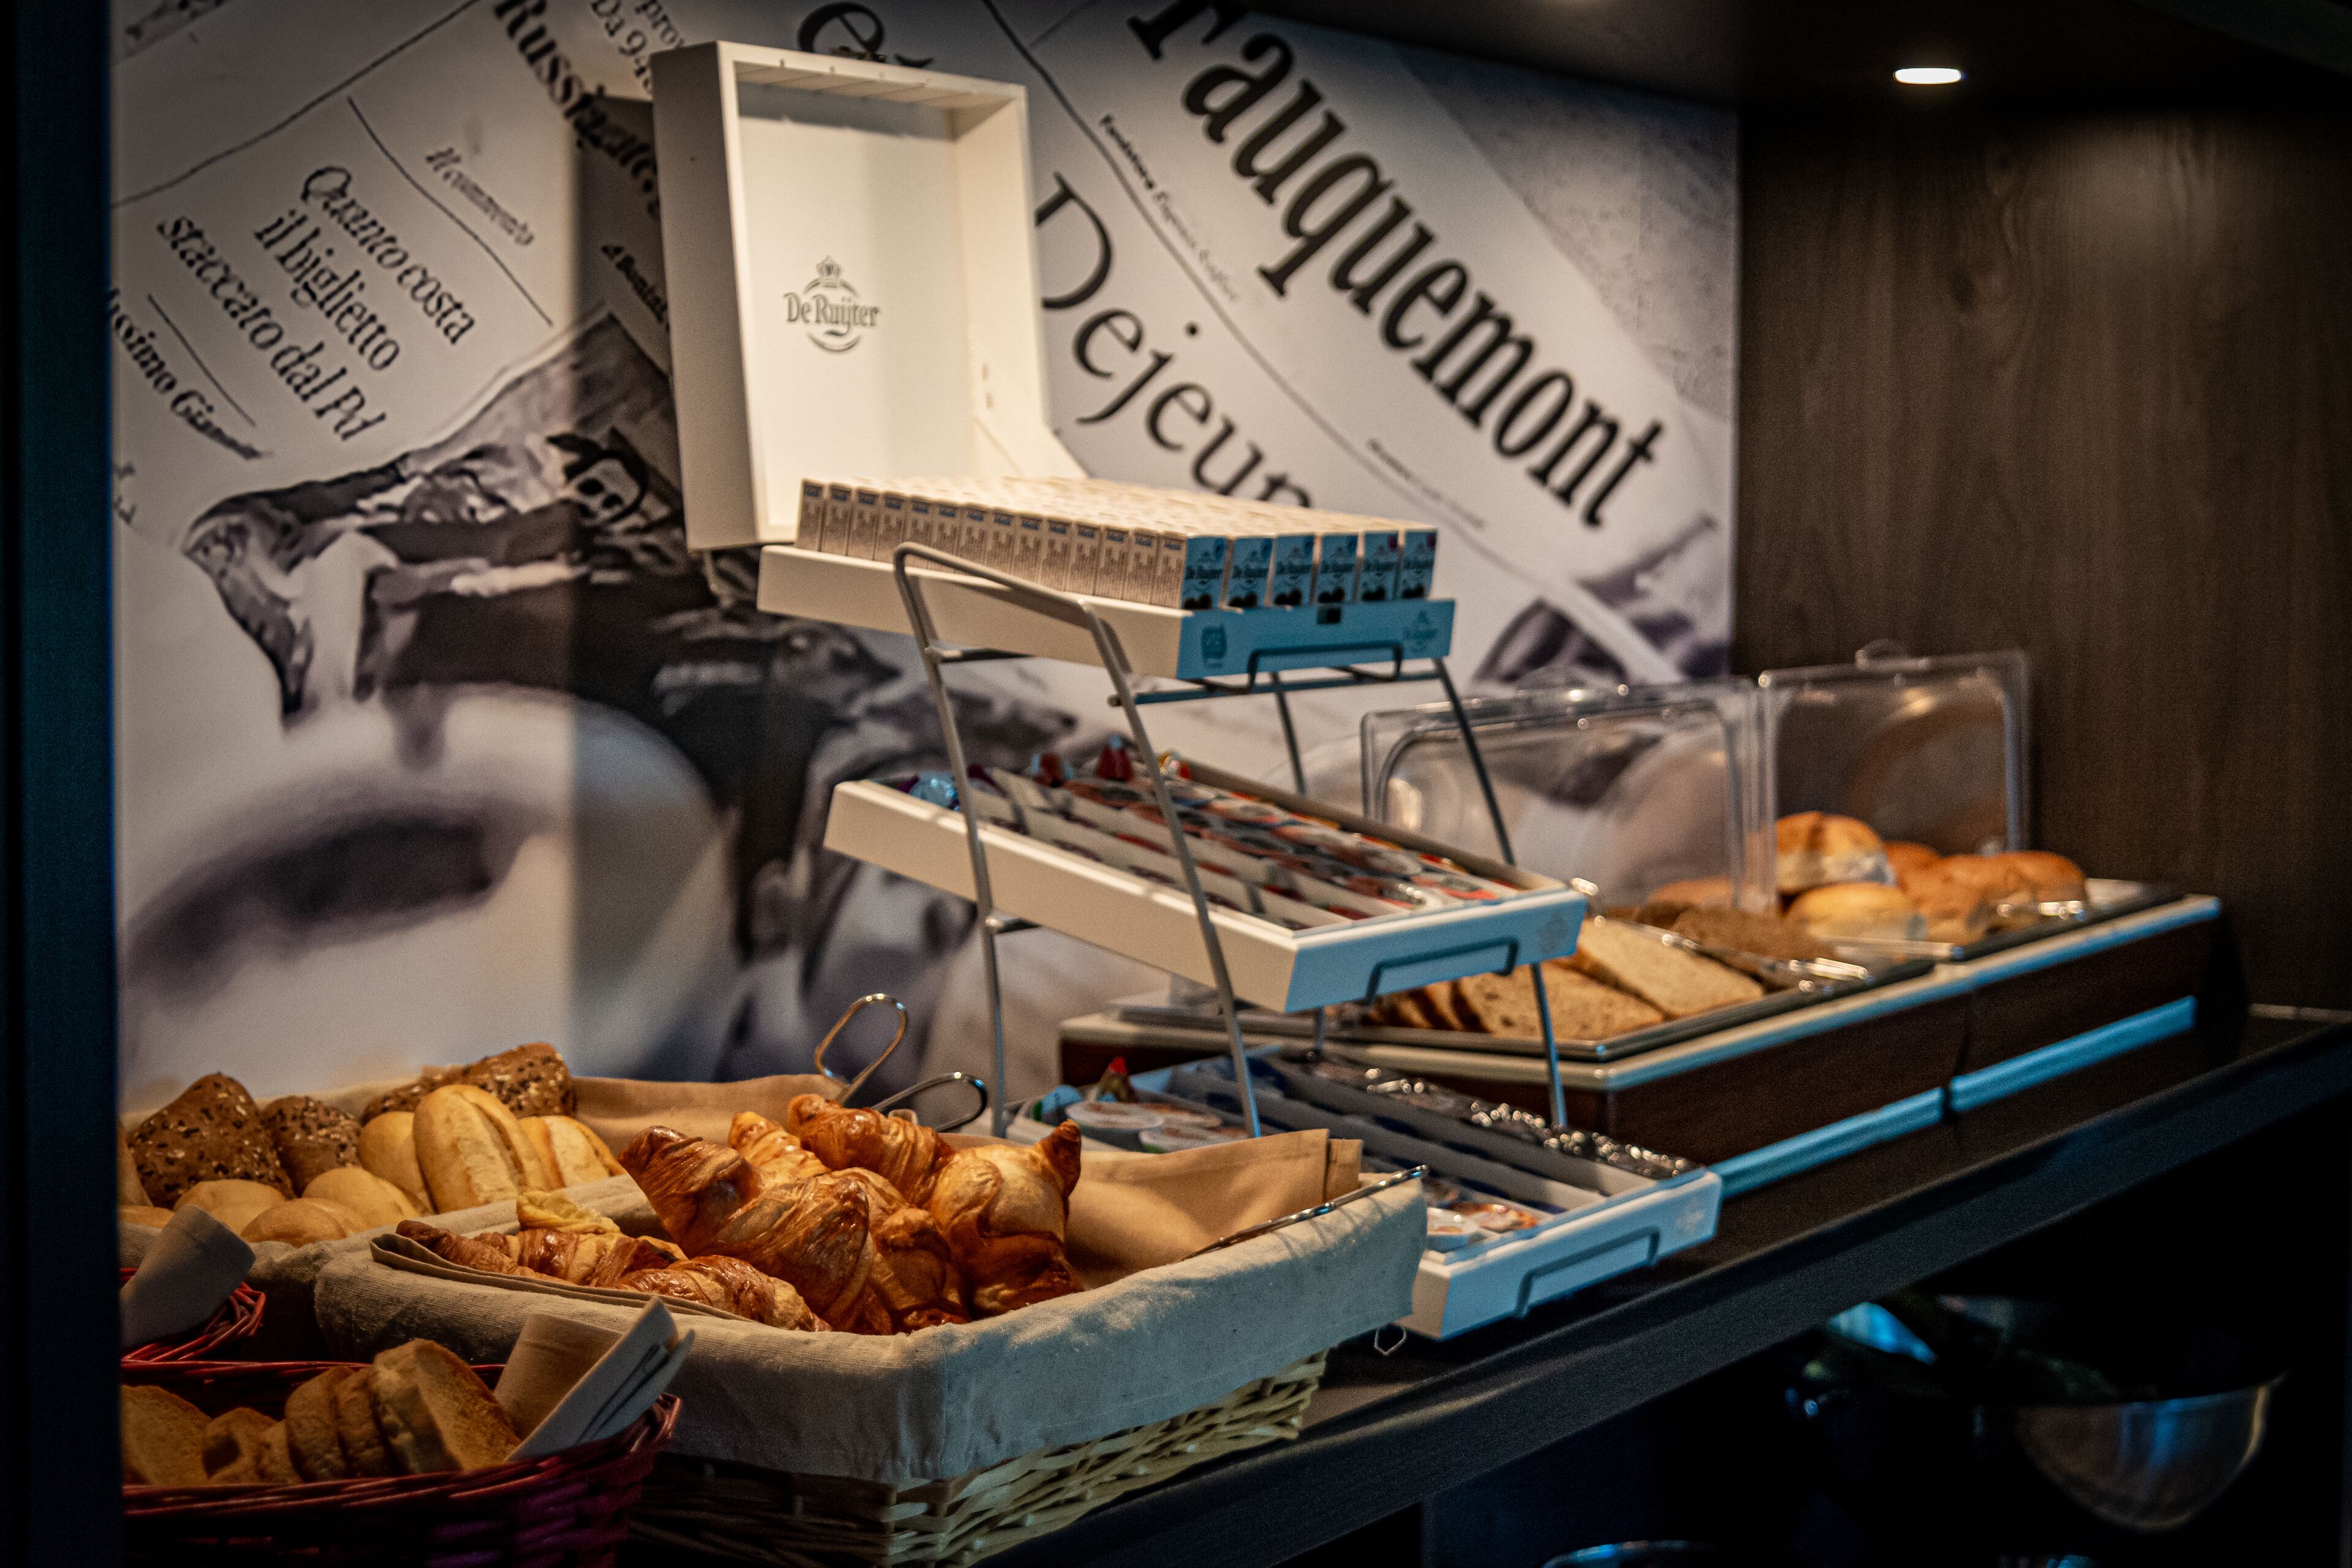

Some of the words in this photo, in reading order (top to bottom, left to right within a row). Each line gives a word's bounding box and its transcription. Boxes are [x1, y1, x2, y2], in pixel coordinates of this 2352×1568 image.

[253, 209, 307, 250] il
[276, 226, 401, 372] biglietto
[301, 165, 409, 270] Quanto
[397, 264, 476, 345] costa
[156, 215, 284, 350] staccato
[270, 341, 347, 402] dal
[314, 385, 387, 442] Pd
[782, 292, 810, 323] De
[812, 293, 882, 337] Ruijter
